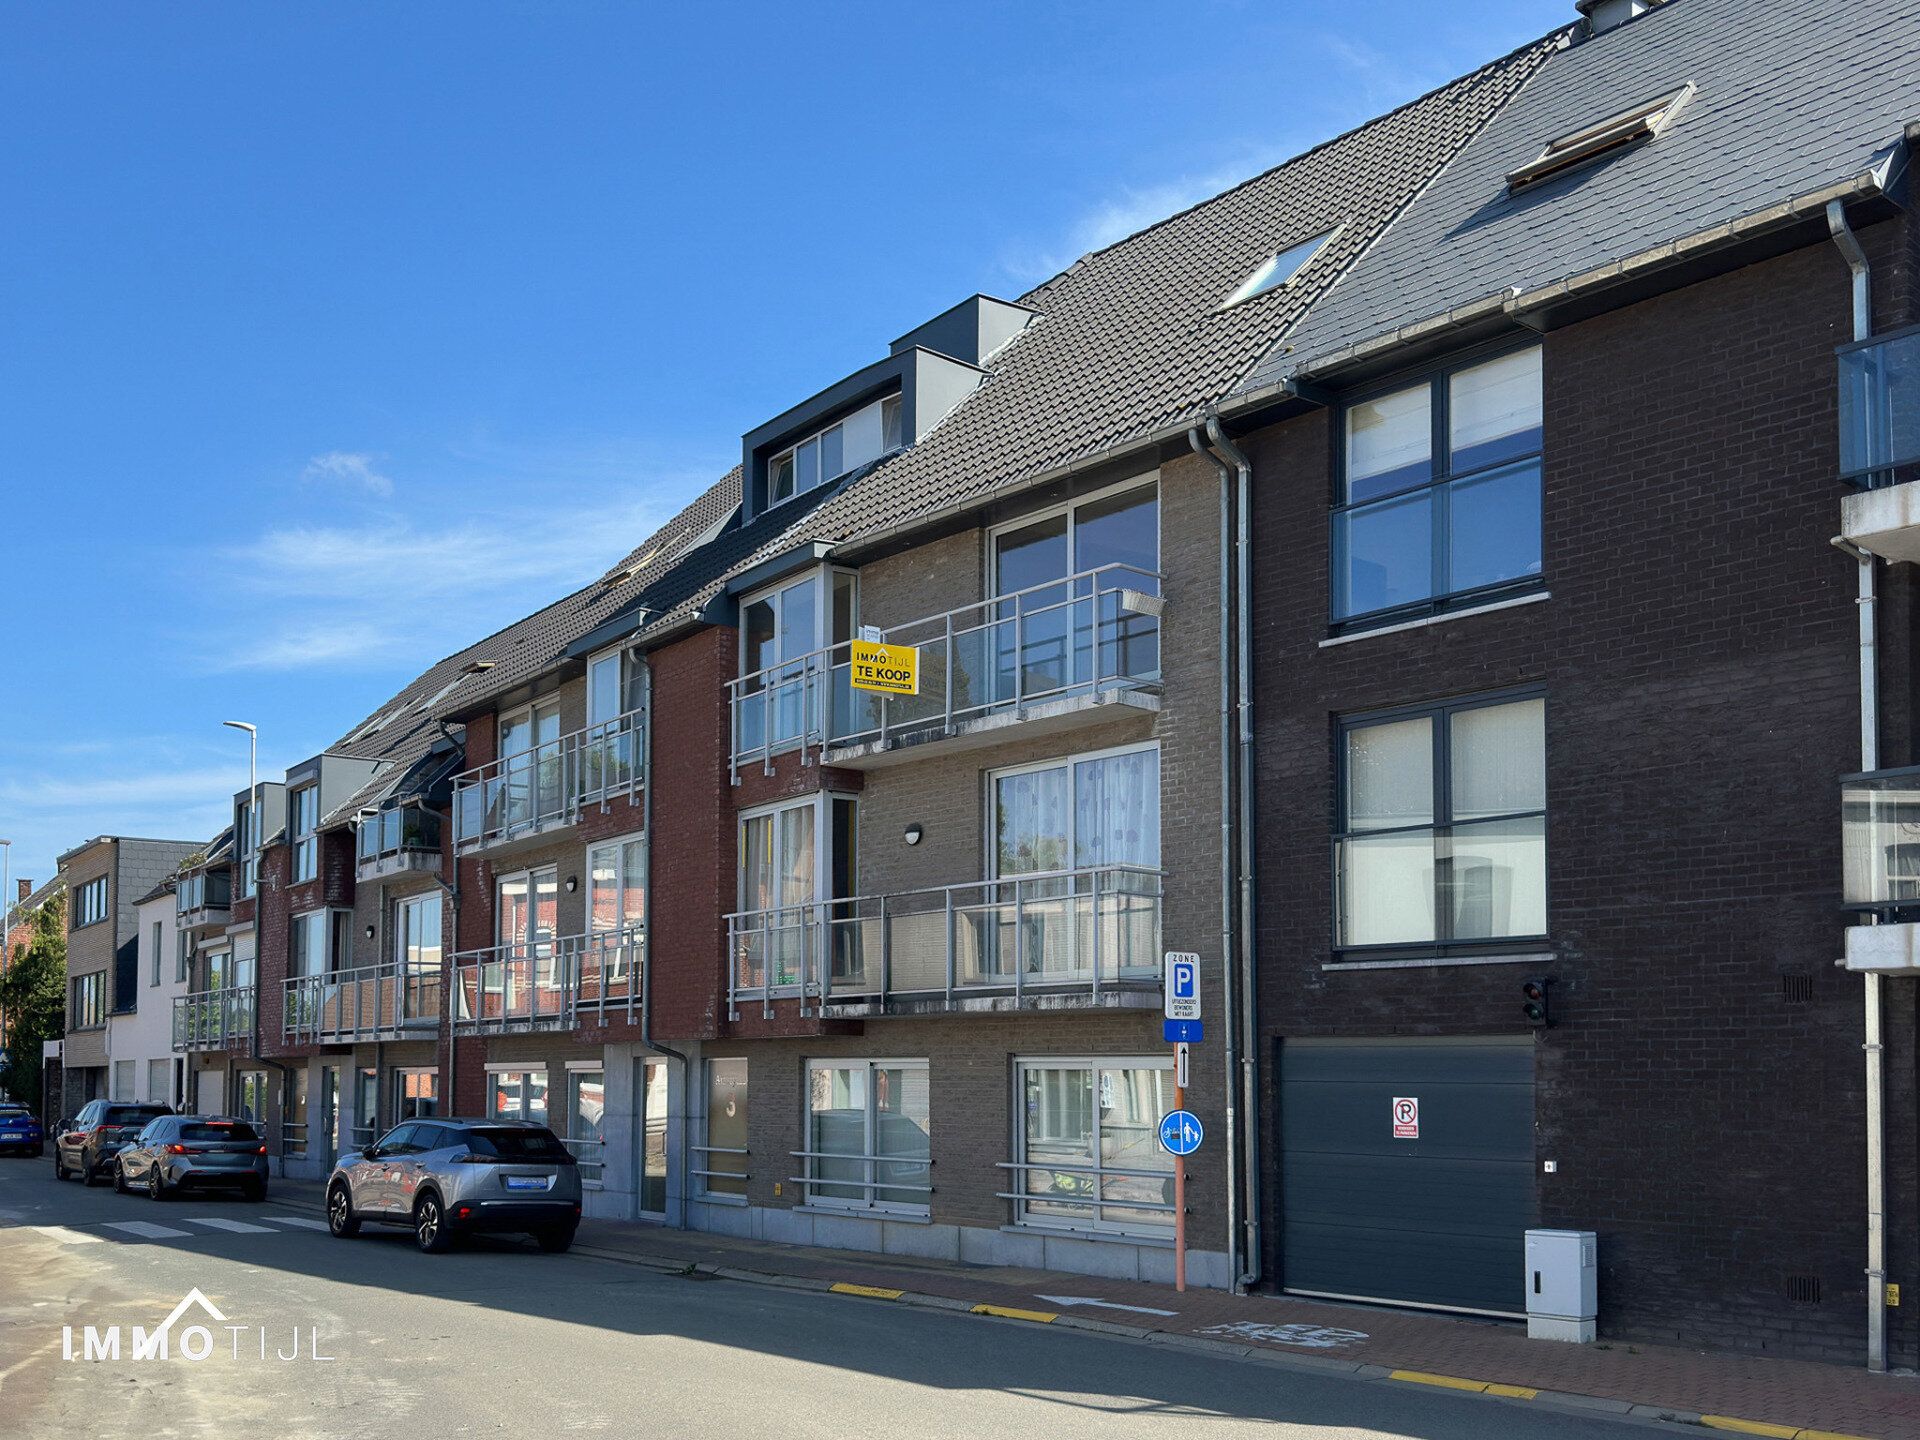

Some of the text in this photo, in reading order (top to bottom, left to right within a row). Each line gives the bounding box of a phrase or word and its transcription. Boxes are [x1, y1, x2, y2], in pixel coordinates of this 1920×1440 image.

[857, 665, 873, 677] TE
[877, 668, 911, 682] KOOP
[1173, 954, 1194, 963] ZONE
[1177, 967, 1191, 993] P
